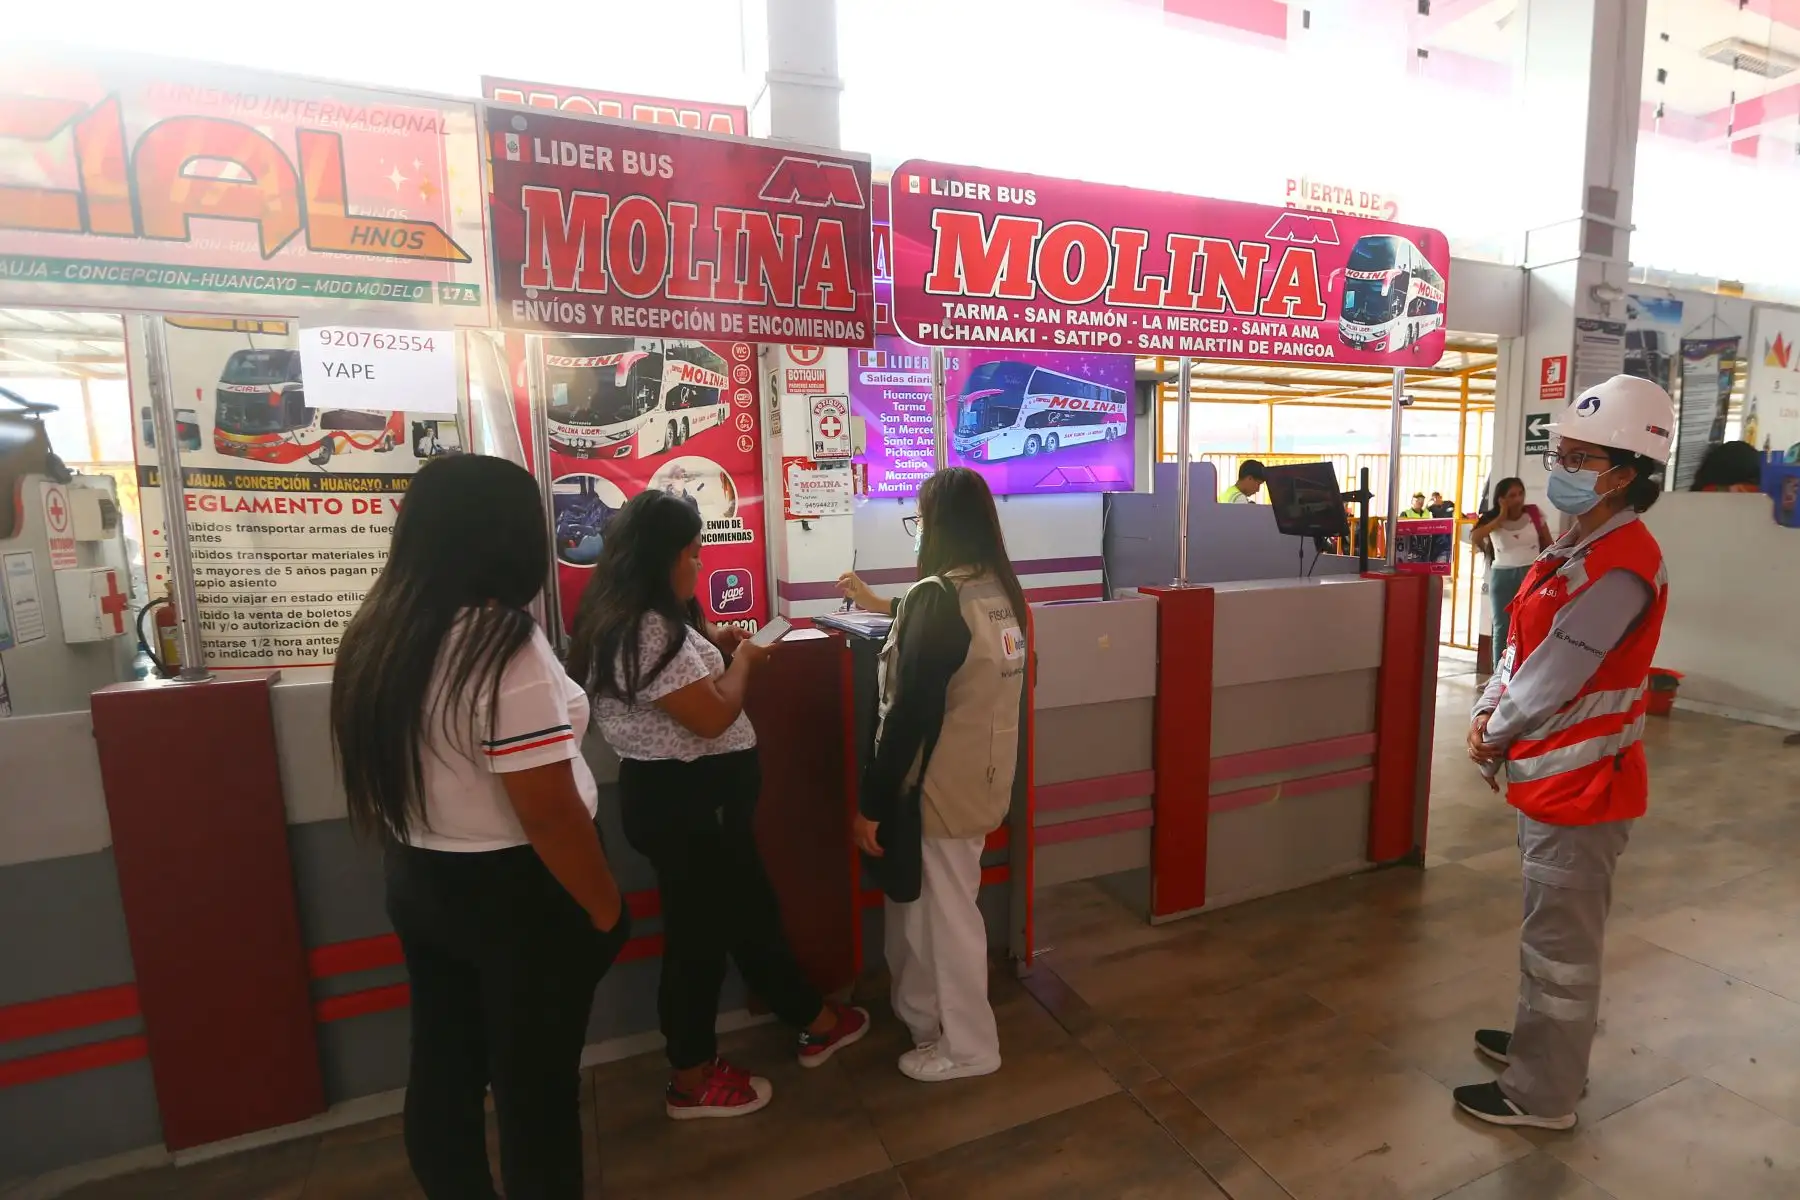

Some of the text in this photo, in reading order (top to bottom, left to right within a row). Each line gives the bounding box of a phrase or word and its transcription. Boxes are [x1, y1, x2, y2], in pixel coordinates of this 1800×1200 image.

[264, 95, 451, 136] INTERNACIONAL
[534, 137, 674, 180] LIDER BUS
[930, 178, 1036, 207] LIDER BUS
[1359, 191, 1382, 211] DE
[350, 225, 426, 251] HNOS
[521, 184, 857, 312] MOLINA
[926, 208, 1327, 321] MOLINA
[1346, 270, 1388, 279] MOLINA
[315, 279, 352, 295] MDO
[355, 282, 424, 299] MODELO
[1417, 282, 1444, 303] MOLINA
[512, 297, 865, 341] ENVÍOS Y RECEPCIÓN DE ENCOMIENDAS
[942, 302, 1320, 340] TARMA SAN RAMÓN LA MERCED SANTA ANA
[319, 329, 436, 353] 920762554
[918, 323, 1335, 358] PICHANAKI SATIPO SAN MARTIN DE PANGOA
[735, 346, 747, 354] WC
[547, 352, 623, 367] MOLINA
[890, 355, 960, 371] LIDER US
[322, 361, 376, 380] YAPE
[680, 364, 724, 388] MOLINA
[788, 369, 825, 381] BOTIQUIN
[866, 374, 933, 384] Salidas diari
[892, 401, 926, 411] Tarma
[1047, 396, 1117, 412] MOLINA
[880, 412, 932, 423] San Ramó
[883, 424, 896, 434] La
[883, 436, 914, 446] Santa
[1526, 443, 1548, 451] SALIDA
[885, 447, 934, 457] Pichanaki
[895, 459, 928, 470] Satipo
[186, 474, 226, 488] JAUJA
[235, 473, 311, 491] CONCEPCIÓN
[320, 476, 383, 492] HUANCAYO
[800, 480, 841, 489] MOLINA
[877, 481, 913, 492] Martin
[184, 494, 343, 516] EGLAMENTO
[352, 498, 383, 515] DE
[236, 523, 305, 535] transportar
[309, 525, 347, 534] armas
[351, 524, 366, 534] de
[369, 524, 395, 536] fueg
[706, 518, 742, 531] ENVIO DE
[701, 531, 752, 544] NCOMIENDAS
[238, 549, 308, 561] transportar
[312, 550, 375, 560] materiales
[206, 566, 261, 577] mayores
[265, 566, 281, 576] de
[285, 566, 293, 576] 5
[296, 565, 327, 576] años
[330, 566, 367, 577] pagan
[229, 578, 277, 588] asiento
[232, 594, 268, 606] viajar
[271, 595, 287, 603] en
[290, 593, 333, 603] estado
[718, 586, 744, 610] yape
[234, 610, 245, 620] la
[249, 610, 283, 620] venta
[287, 610, 303, 619] de
[307, 608, 353, 619] boletos
[220, 621, 239, 633] y/o
[324, 619, 339, 628] de
[251, 638, 270, 648] 1/2
[274, 637, 302, 648] hora
[306, 636, 340, 646] antes
[220, 649, 274, 659] indicado
[277, 647, 293, 657] no
[296, 647, 319, 658] hay
